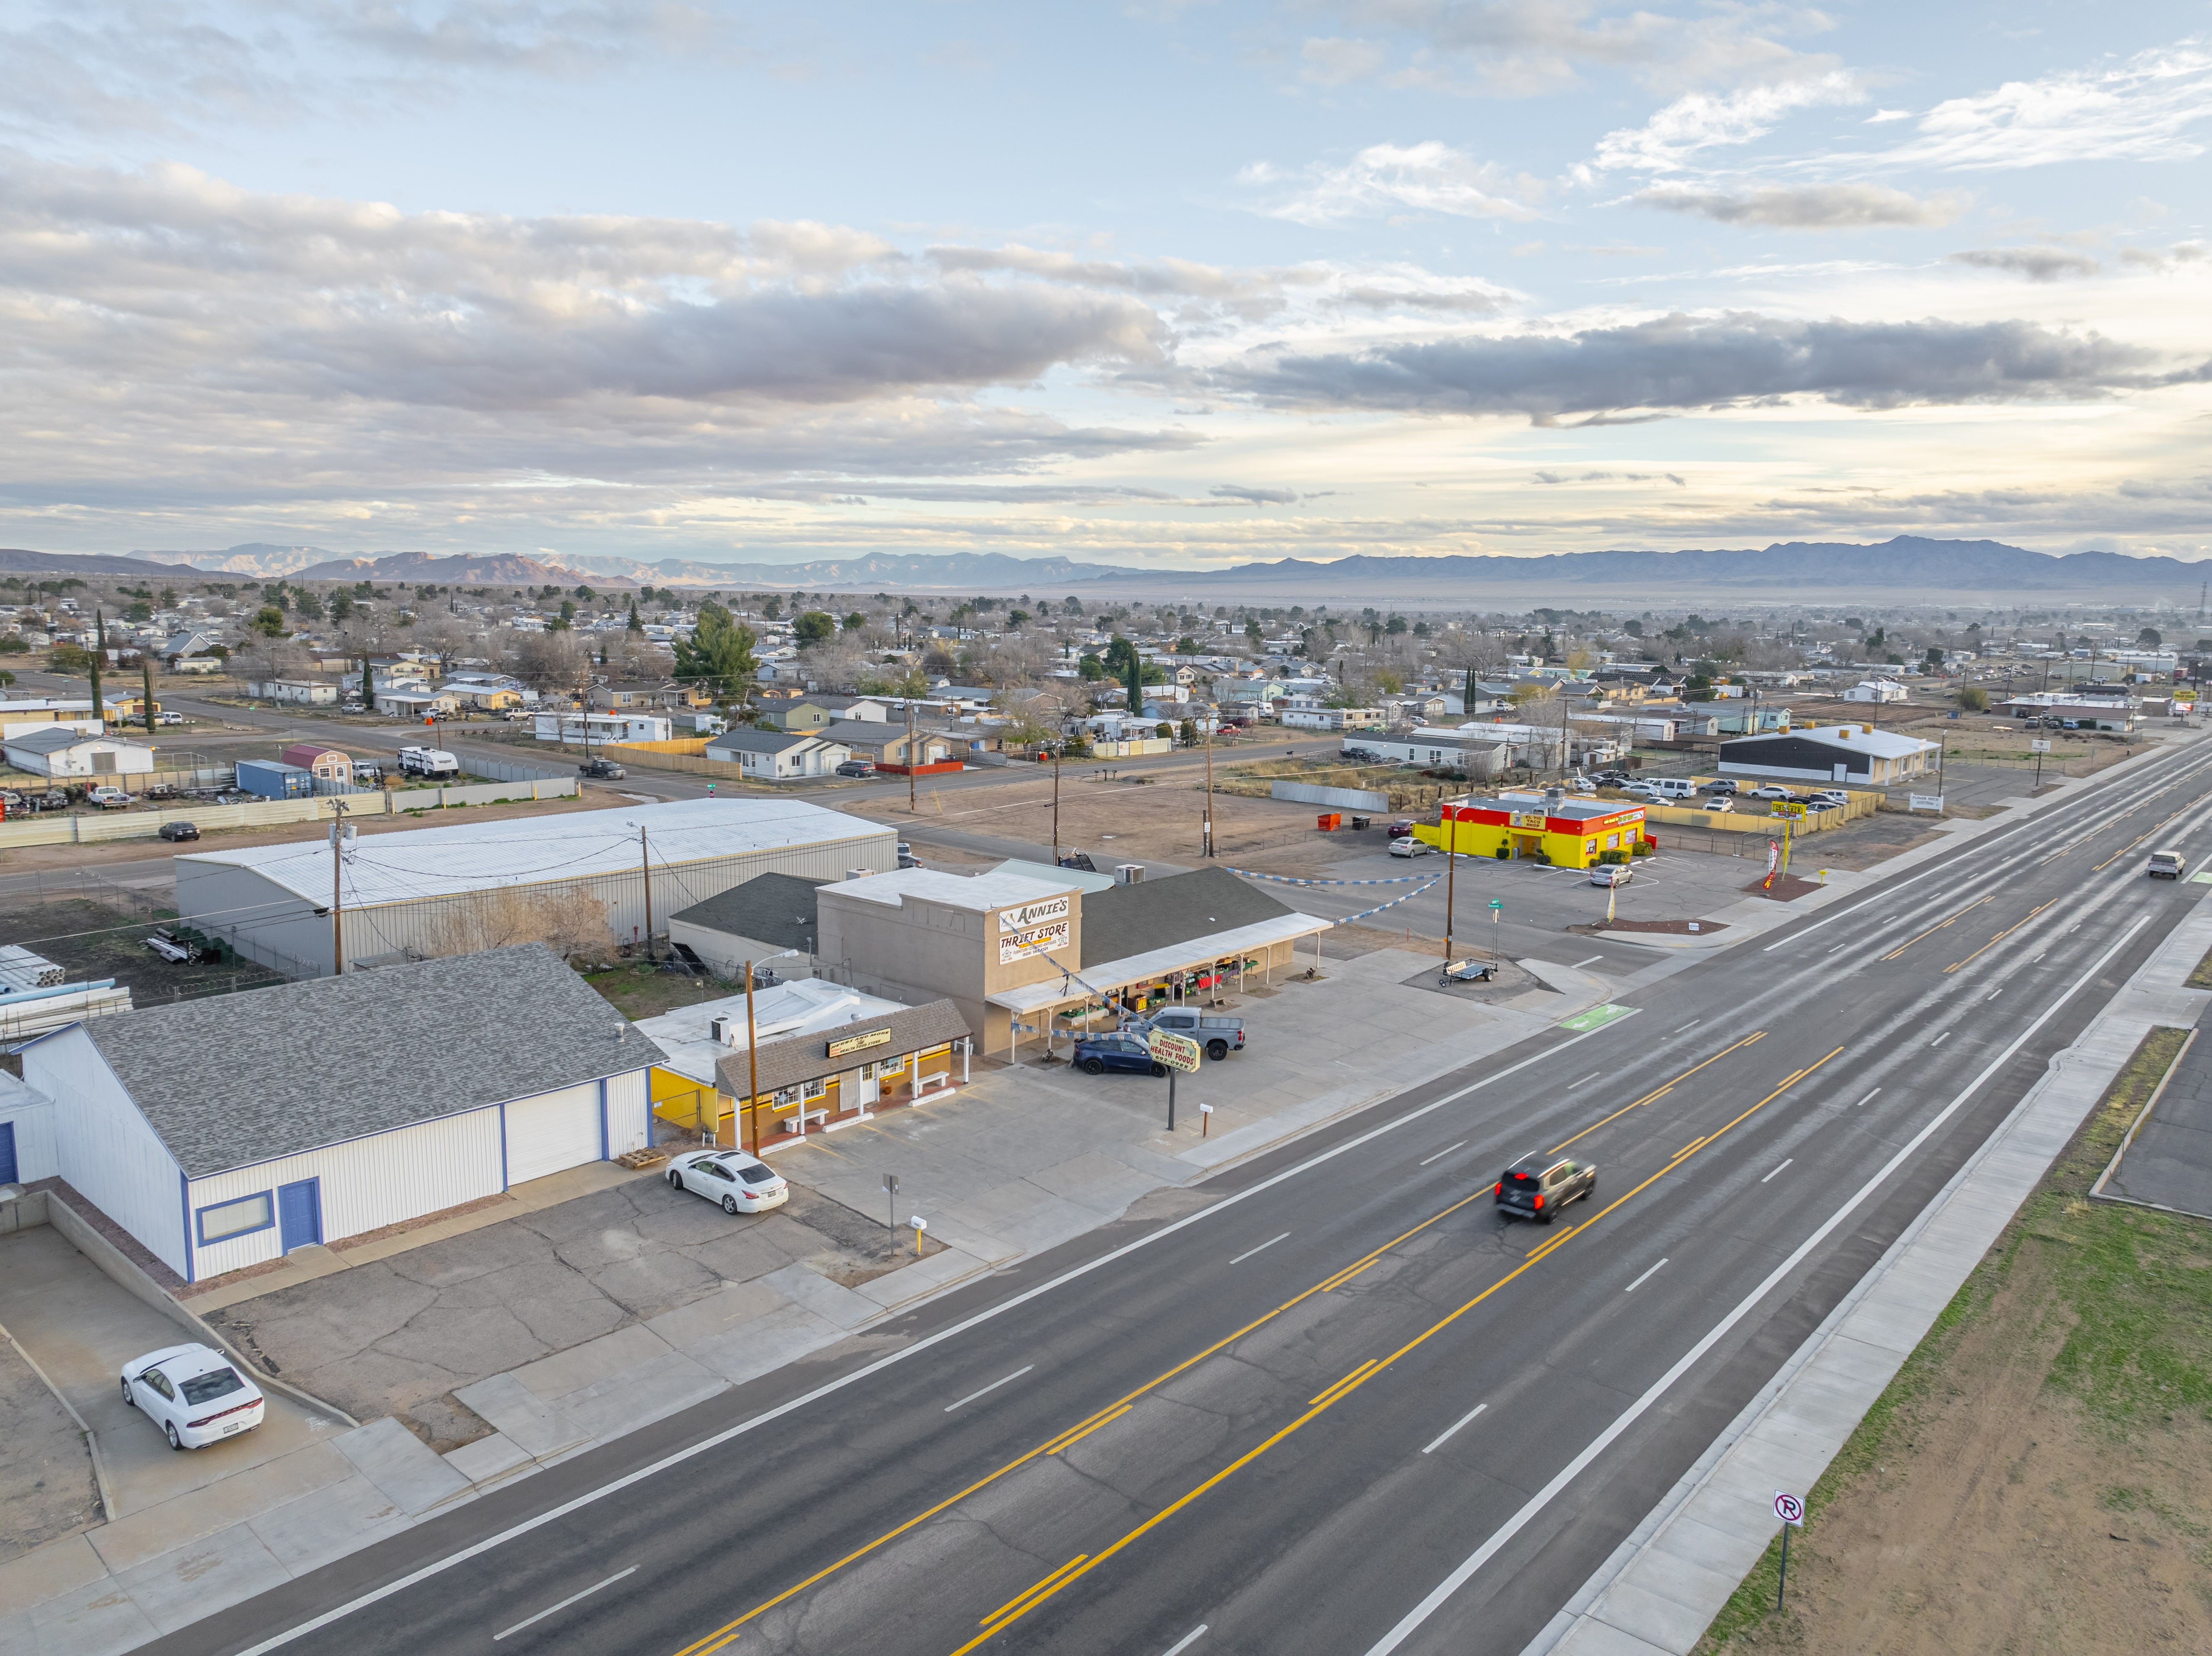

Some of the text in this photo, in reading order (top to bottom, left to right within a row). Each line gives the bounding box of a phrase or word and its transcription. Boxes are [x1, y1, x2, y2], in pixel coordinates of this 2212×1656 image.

[1787, 805, 1802, 814] TIO
[1017, 899, 1067, 924] ANNIE'S
[1001, 931, 1036, 948] THRIFT
[1038, 922, 1067, 939] STORE
[831, 1039, 853, 1049] HERBS
[1160, 1039, 1185, 1054] DISCOUNT
[1150, 1045, 1194, 1065] HEALTH FOODS
[1156, 1056, 1188, 1069] 692-0988
